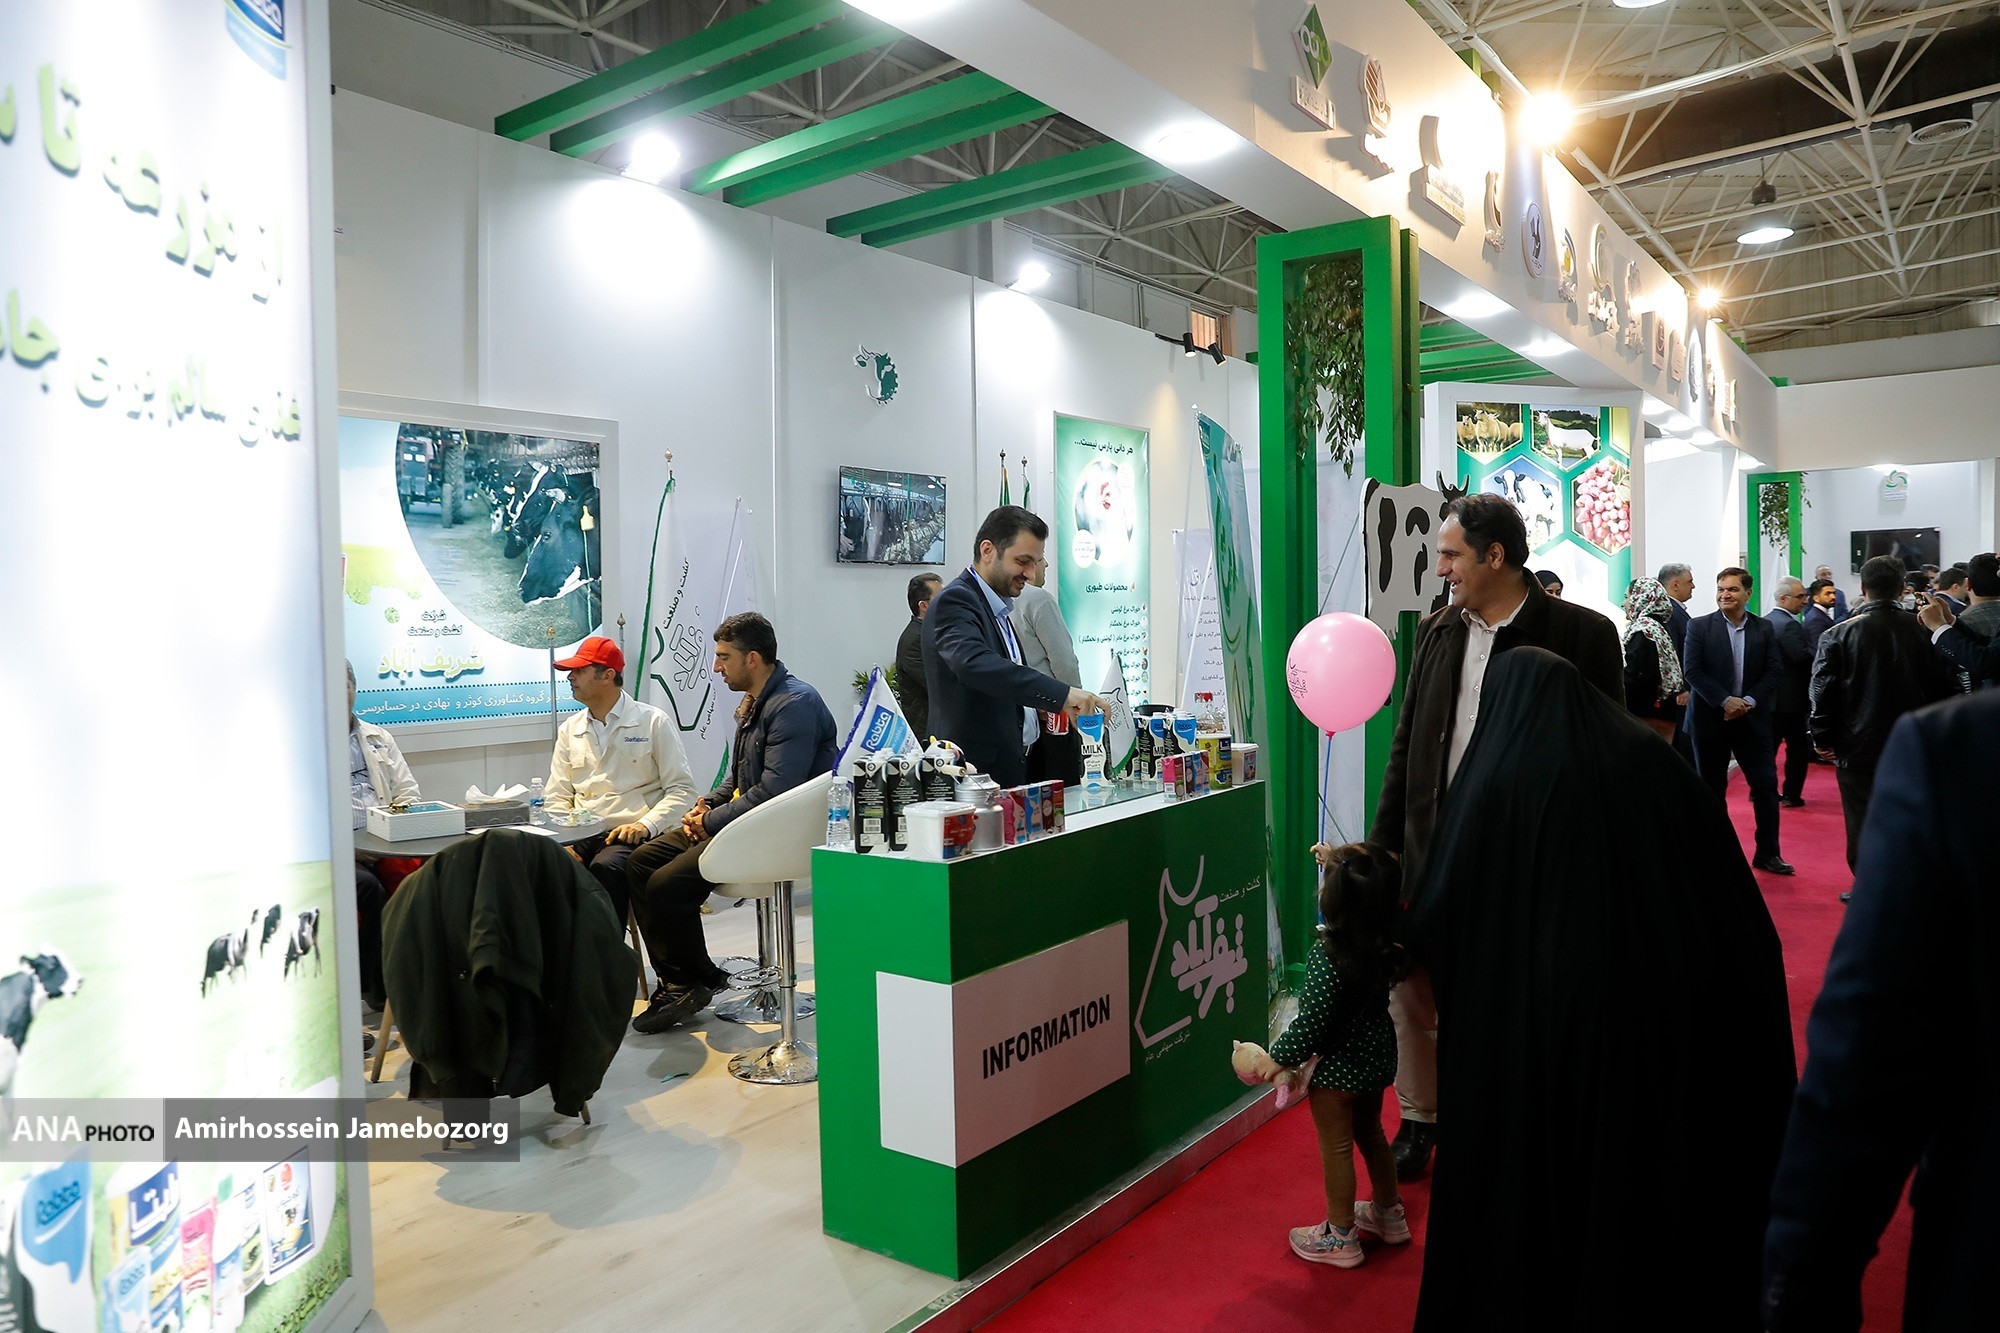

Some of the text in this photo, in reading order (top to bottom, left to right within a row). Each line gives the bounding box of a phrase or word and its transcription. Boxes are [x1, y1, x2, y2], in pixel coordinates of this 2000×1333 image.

[37, 62, 82, 178] تا
[421, 608, 447, 623] شرکت
[663, 596, 680, 629] صنعت
[378, 643, 485, 684] شریف آباد
[423, 697, 450, 711] نهادی
[463, 694, 482, 709] کوثر
[484, 693, 524, 708] کشاورزی
[526, 690, 544, 704] گروه
[355, 700, 407, 716] حسابرسی
[409, 701, 420, 712] در
[455, 701, 462, 709] و
[865, 711, 891, 750] Rabta
[1082, 744, 1104, 755] MILK
[1246, 875, 1261, 891] کشت
[1220, 889, 1240, 902] صنعت
[982, 993, 1111, 1080] INFORMATION
